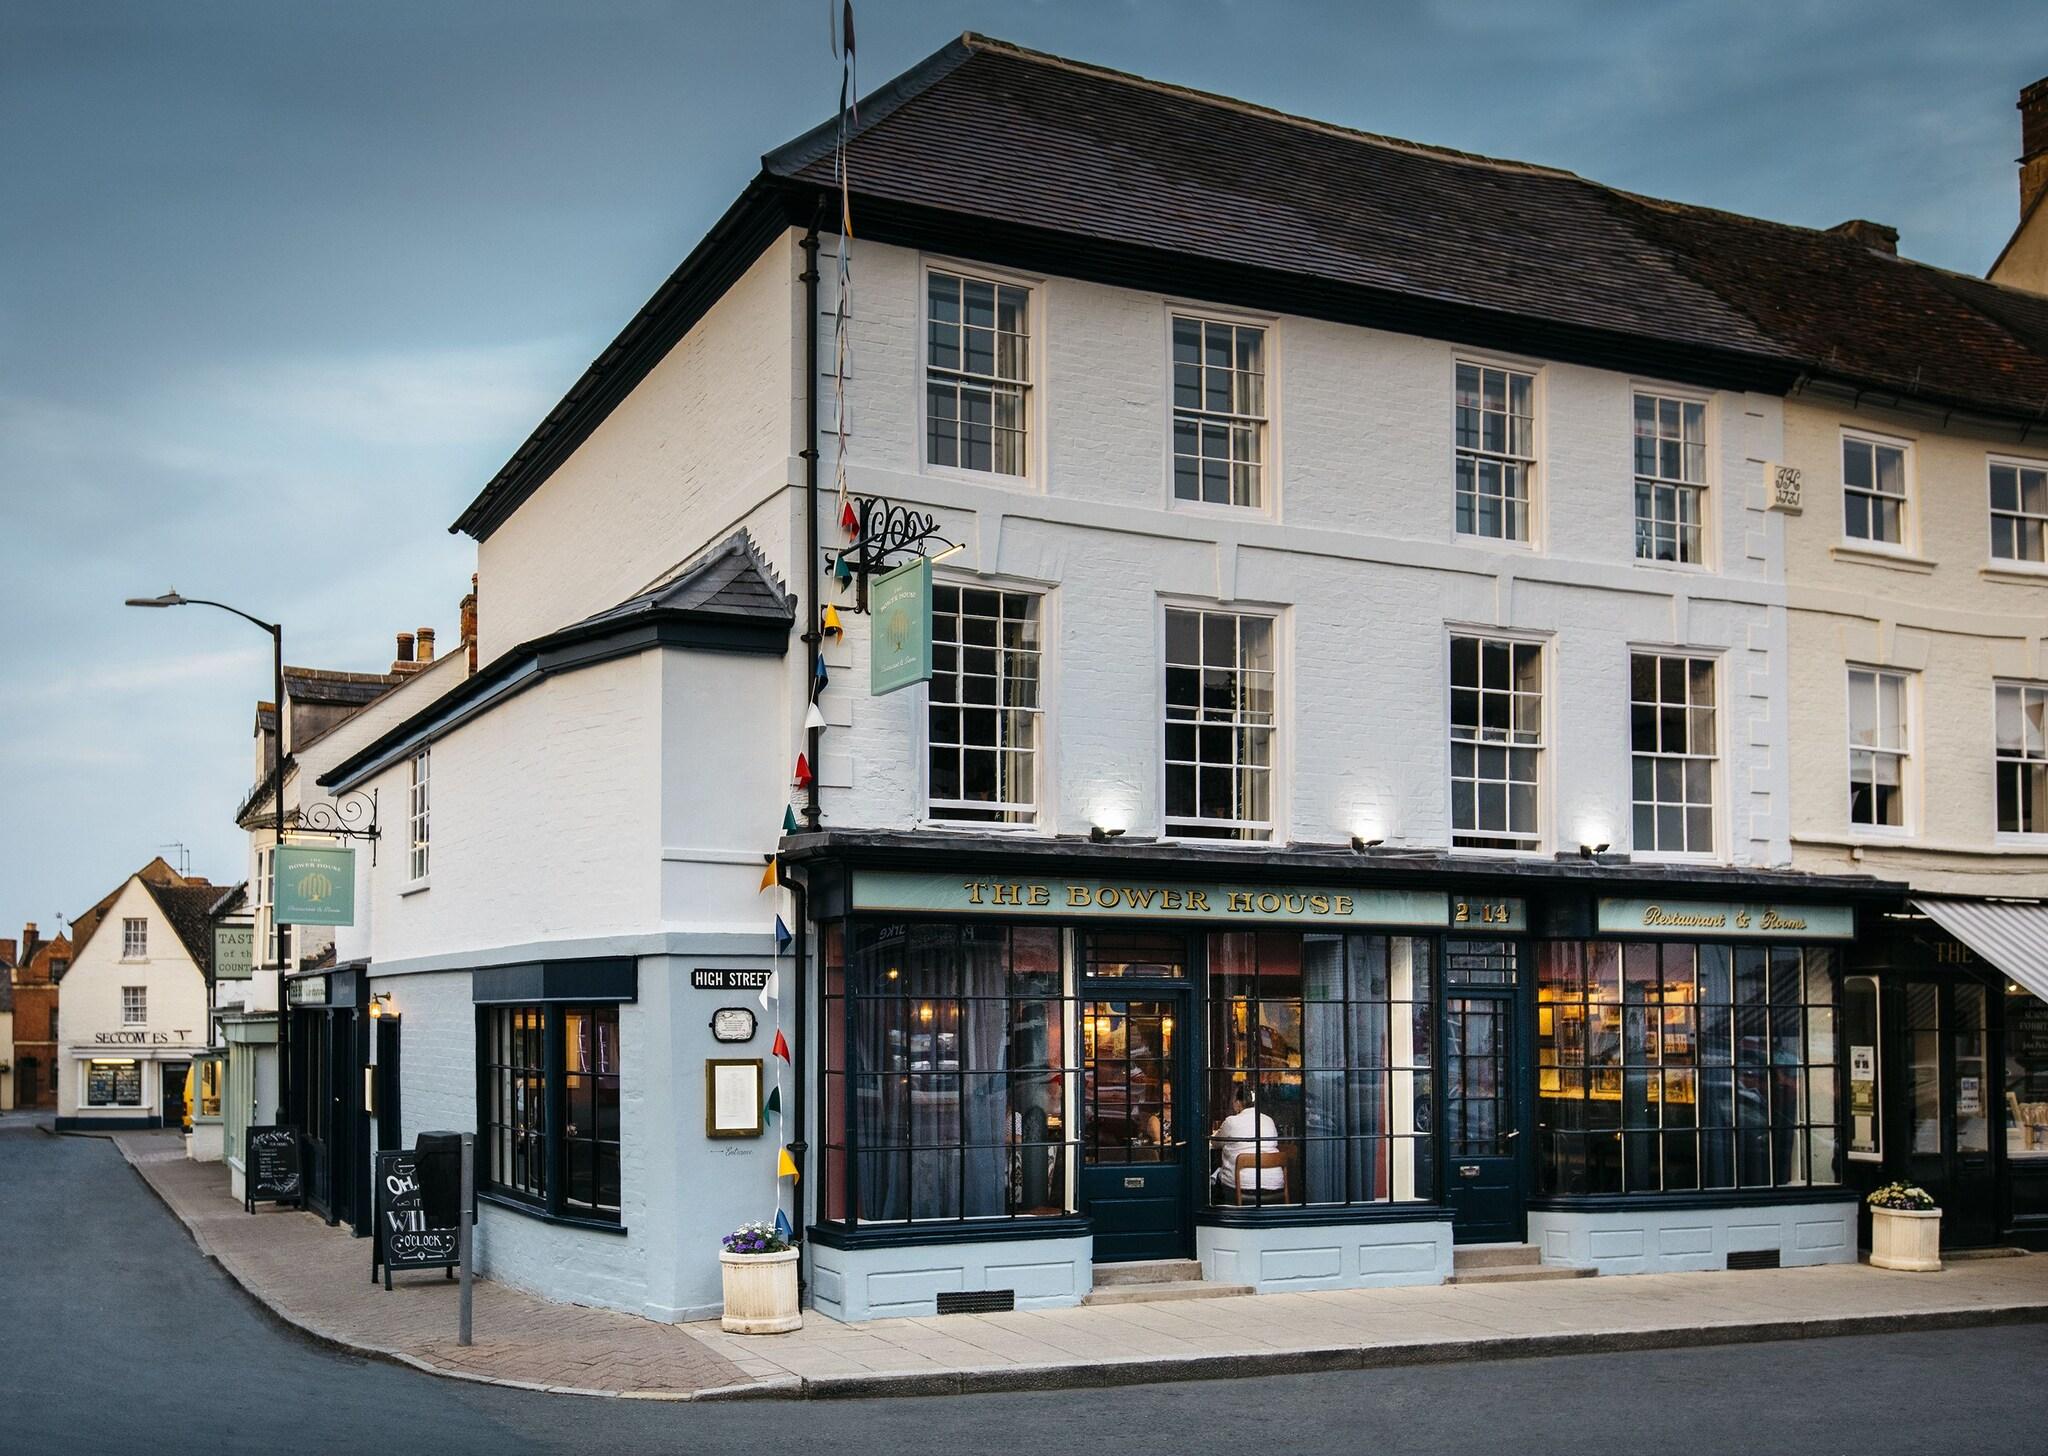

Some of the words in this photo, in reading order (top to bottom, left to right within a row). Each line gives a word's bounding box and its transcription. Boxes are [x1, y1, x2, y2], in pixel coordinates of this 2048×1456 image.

[964, 882, 1050, 906] THE
[1067, 886, 1210, 912] BOWER
[1227, 891, 1354, 915] HOUSE
[1643, 905, 1726, 928] Restaurant
[1735, 909, 1751, 929] &
[1759, 910, 1807, 931] Rooms
[218, 933, 254, 945] TAST
[240, 950, 252, 959] th
[1933, 942, 1973, 963] THE
[695, 971, 723, 986] HIGH
[729, 972, 770, 987] STREET
[404, 1234, 442, 1247] O'CLOCK
